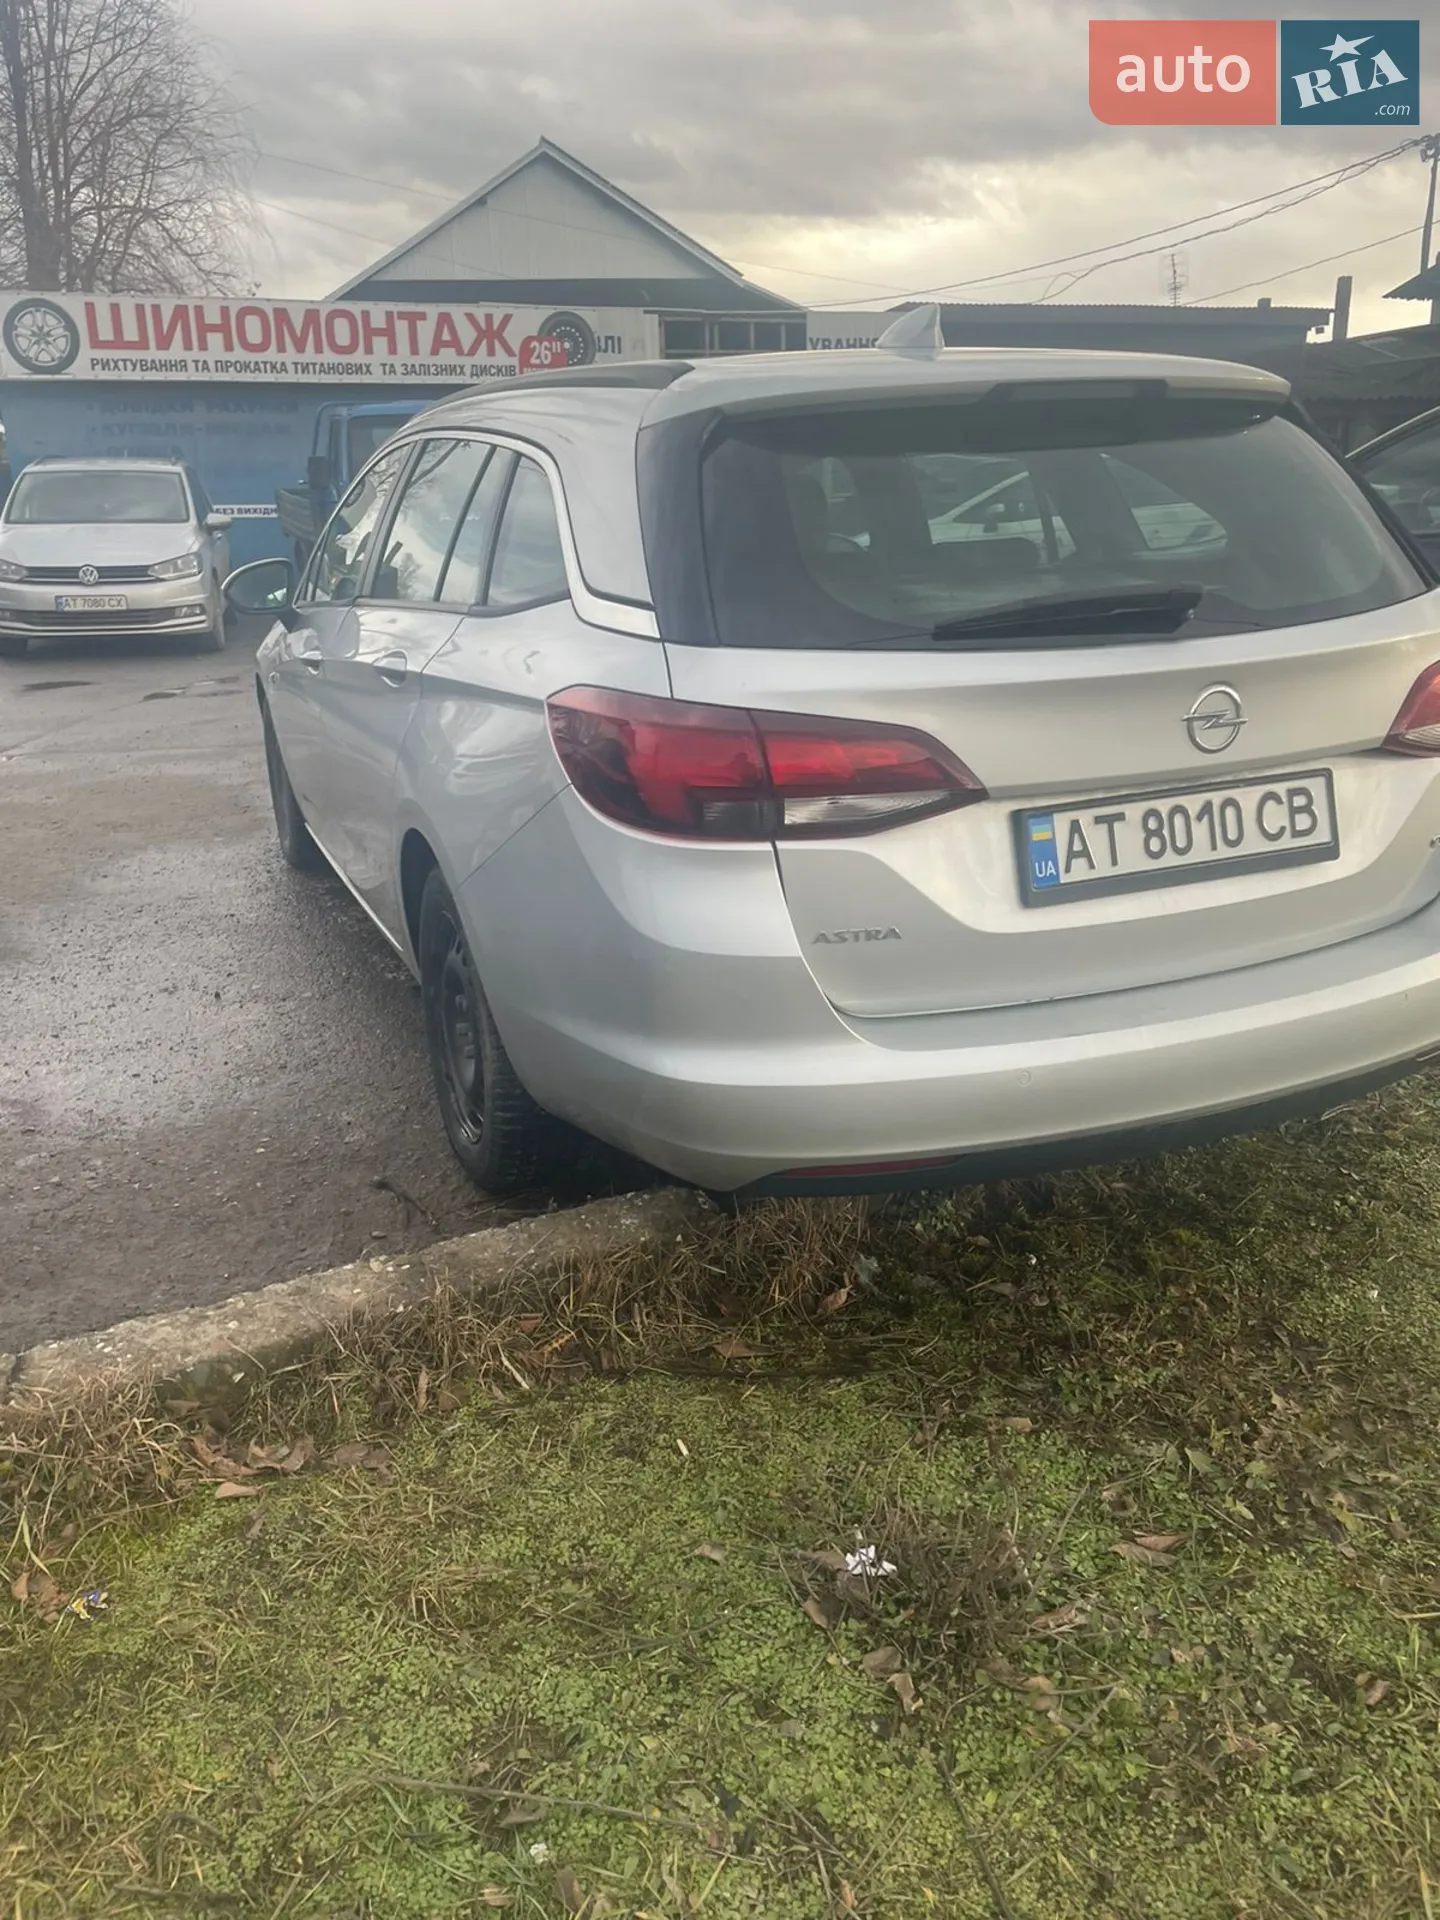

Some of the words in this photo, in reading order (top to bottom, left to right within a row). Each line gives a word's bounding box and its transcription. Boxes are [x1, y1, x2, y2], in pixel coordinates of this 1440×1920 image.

[84, 301, 518, 358] ШИНОМОНТАЖ
[90, 357, 189, 373] РИХТУВАННЯ
[191, 359, 211, 374] ТА
[213, 360, 289, 375] ПРОКАТКА
[291, 361, 373, 376] ТИТАНОВИХ
[380, 363, 397, 376] ТА
[401, 363, 466, 377] ЗАЛІЗНИХ
[469, 364, 517, 378] ДИСКІВ
[236, 507, 278, 516] ВИХІДН
[1064, 811, 1127, 874] AT
[1141, 796, 1245, 861] 8010
[1255, 785, 1319, 842] CB
[1034, 861, 1057, 878] UA
[811, 925, 903, 945] ASTRA
